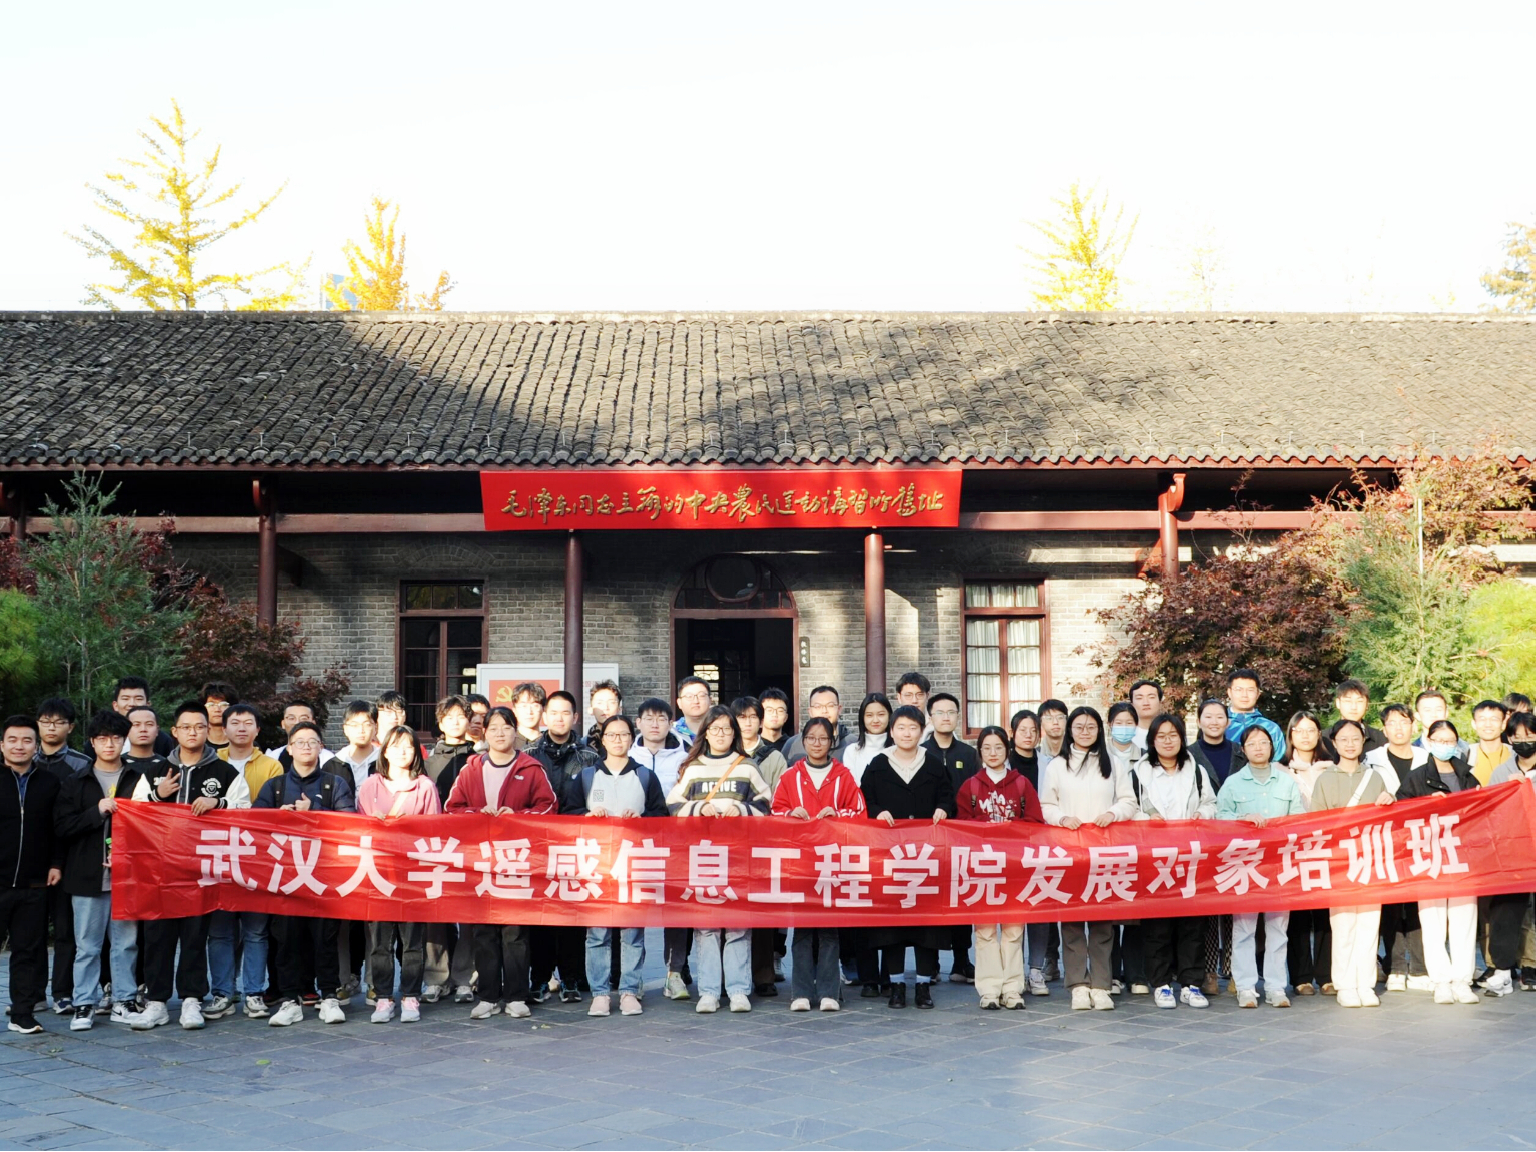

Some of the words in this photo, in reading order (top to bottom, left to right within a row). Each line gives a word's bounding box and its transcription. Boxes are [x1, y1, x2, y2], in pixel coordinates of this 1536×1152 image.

[196, 813, 1470, 908] 武汉大学遥感信息工程学院发展对象培训班
